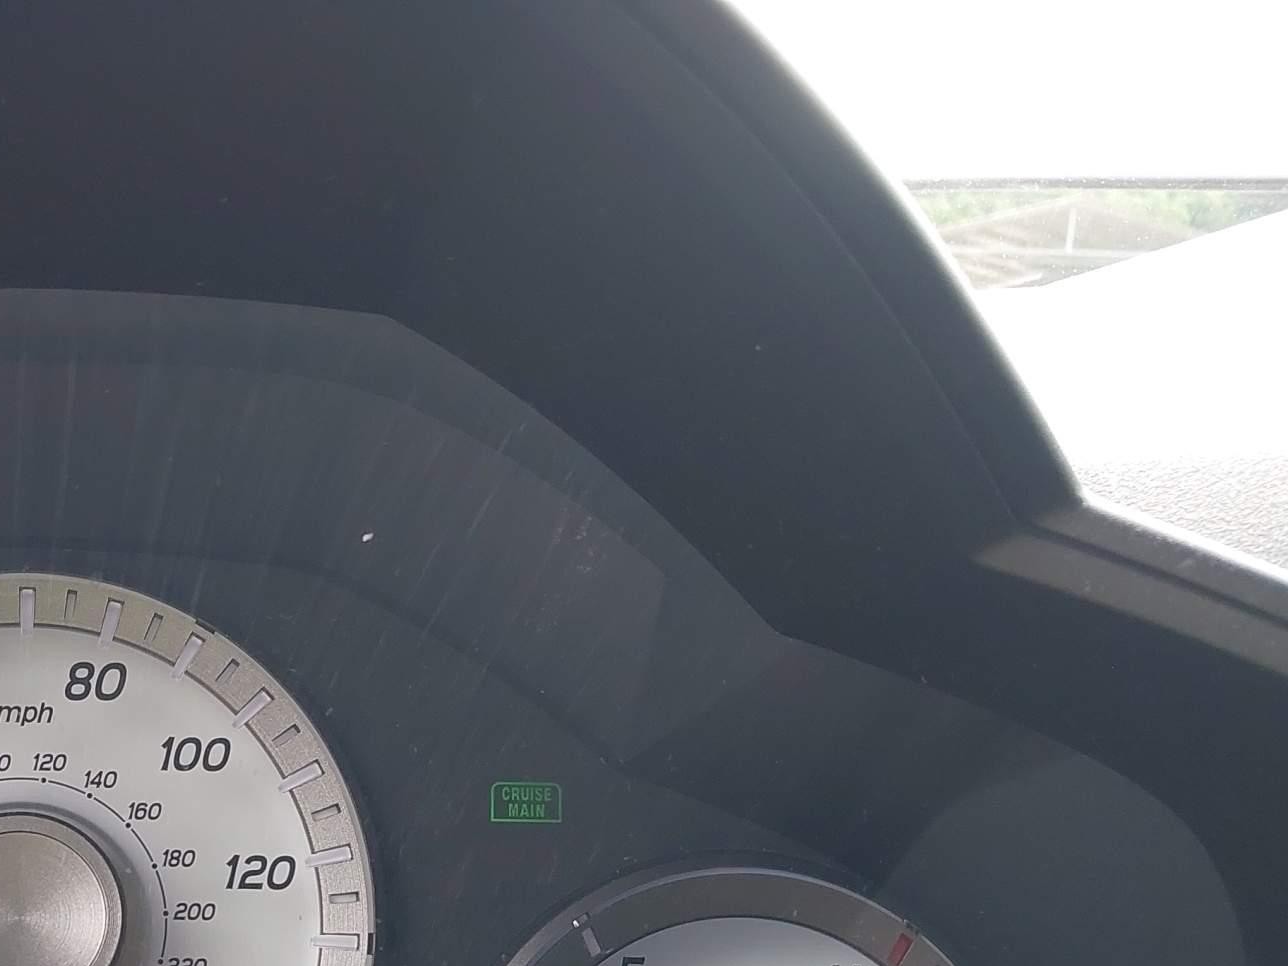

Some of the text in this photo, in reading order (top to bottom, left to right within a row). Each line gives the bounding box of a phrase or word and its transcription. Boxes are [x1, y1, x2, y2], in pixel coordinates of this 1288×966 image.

[64, 662, 127, 700] 80
[32, 753, 66, 772] 120
[160, 736, 231, 772] 100
[84, 770, 118, 789] 140
[501, 787, 552, 801] CRUISE
[127, 802, 162, 821] 160
[507, 803, 546, 818] MAIN
[162, 850, 196, 868] 180
[225, 855, 296, 890] 120
[173, 903, 216, 921] 200
